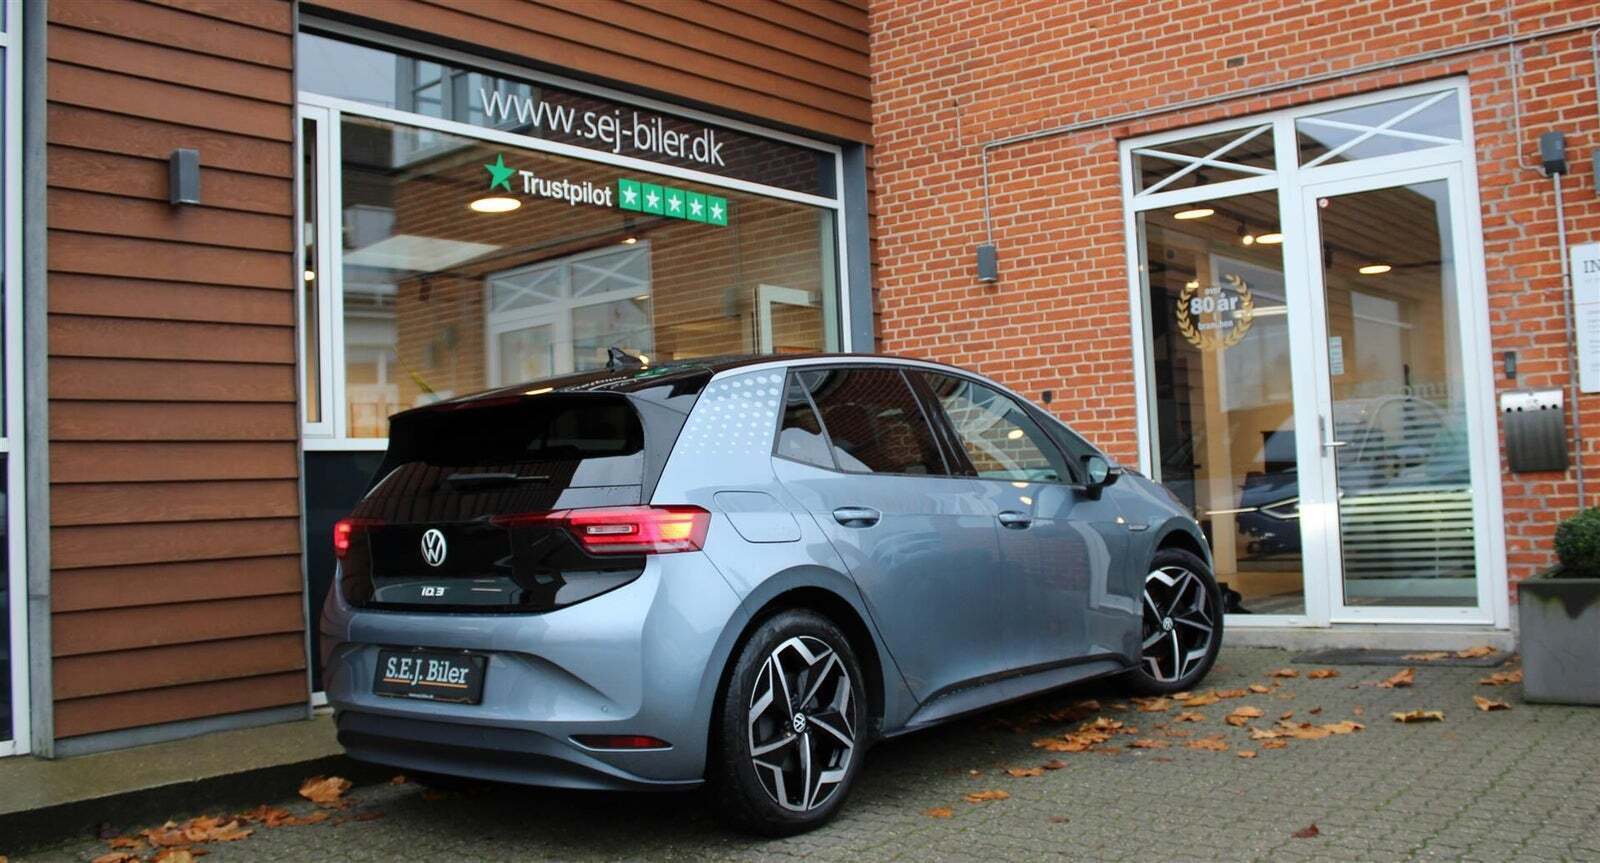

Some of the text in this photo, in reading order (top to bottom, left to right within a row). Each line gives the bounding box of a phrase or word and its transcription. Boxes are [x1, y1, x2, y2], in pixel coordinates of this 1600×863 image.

[480, 88, 725, 166] www.sej-biler.dk
[519, 169, 613, 207] Trustpilot
[1190, 292, 1239, 315] 80 år
[385, 656, 469, 686] S.E.J. Biler
